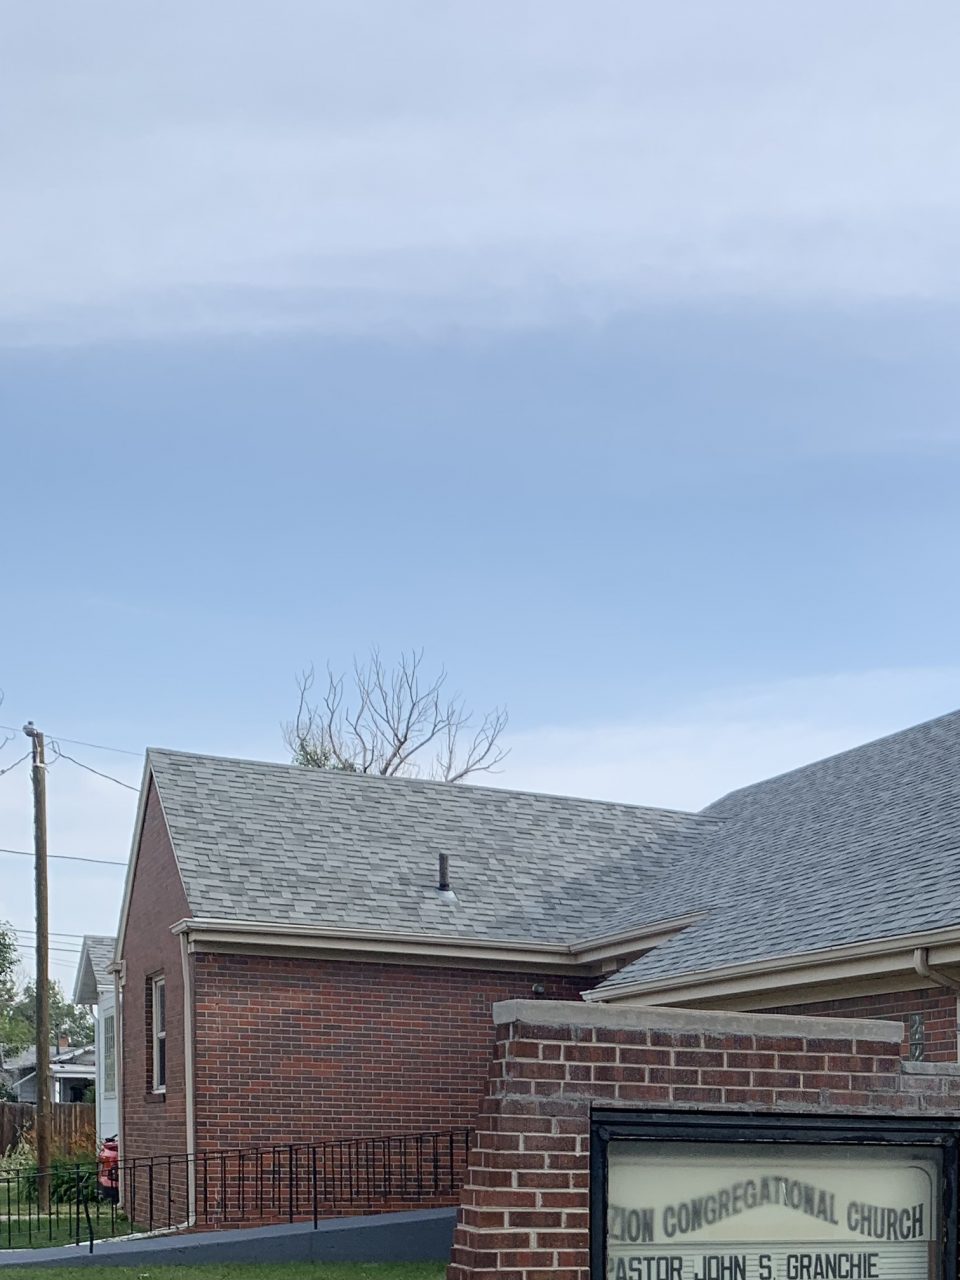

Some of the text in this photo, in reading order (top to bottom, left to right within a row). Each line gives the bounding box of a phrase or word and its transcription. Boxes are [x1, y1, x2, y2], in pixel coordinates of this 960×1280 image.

[663, 1175, 838, 1238] CONGREGATIONAL
[847, 1200, 924, 1240] CHURCH
[759, 1254, 776, 1280] S.
[787, 1253, 879, 1280] GRANCHIE
